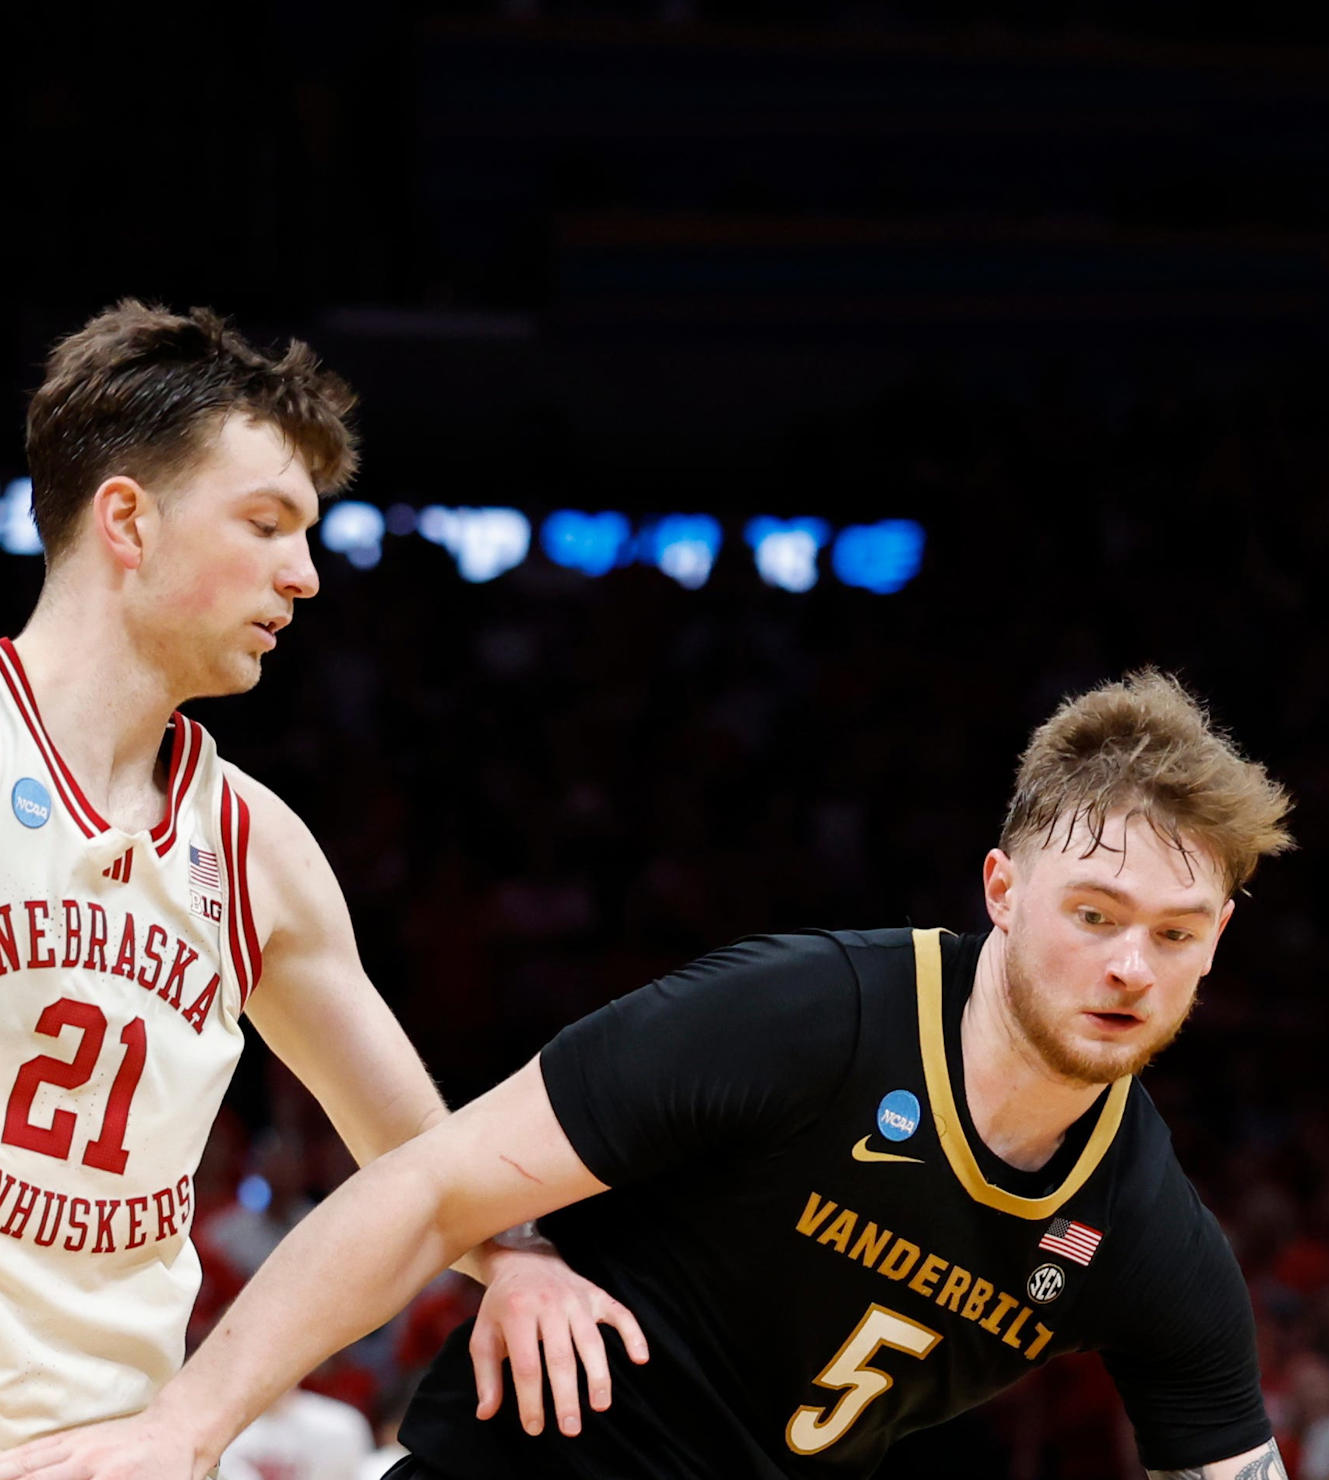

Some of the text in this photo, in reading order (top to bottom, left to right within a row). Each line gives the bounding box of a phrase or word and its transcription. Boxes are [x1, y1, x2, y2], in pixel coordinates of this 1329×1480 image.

[1, 997, 147, 1176] 21
[881, 1109, 915, 1134] NCAA
[795, 1192, 1054, 1361] VANDERBILT
[1030, 1267, 1062, 1300] SEC
[785, 1302, 944, 1455] 5
